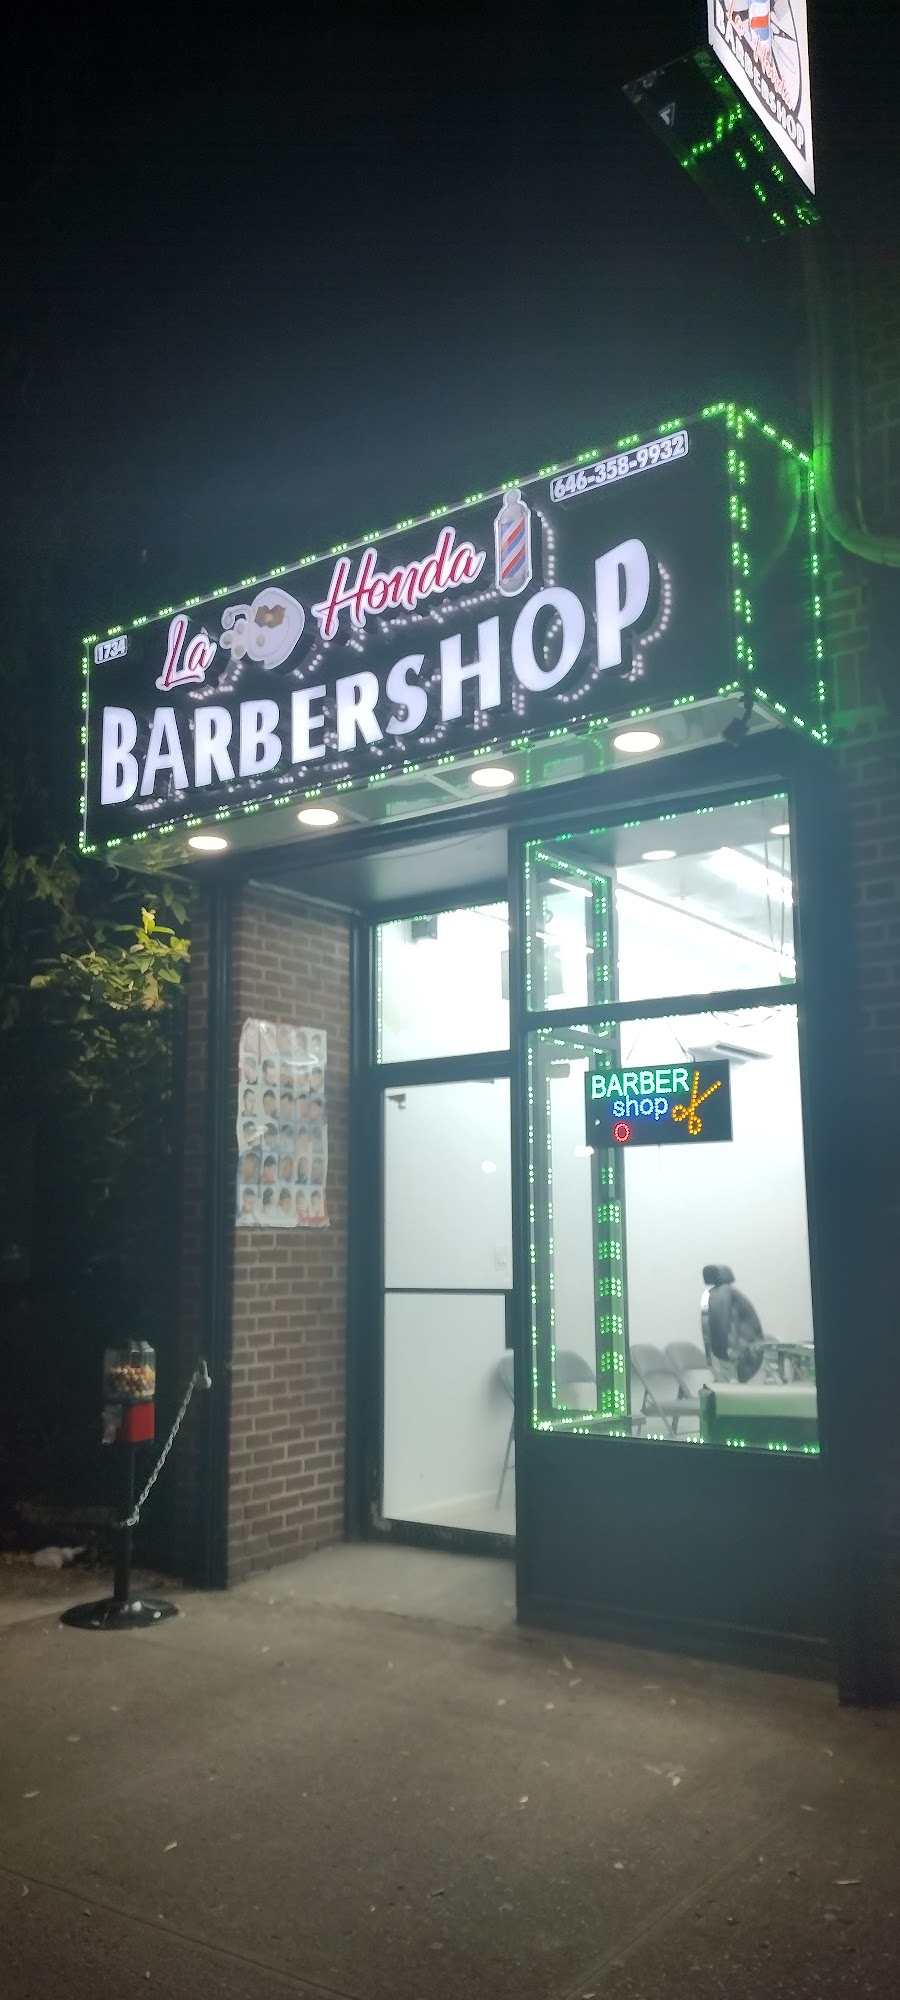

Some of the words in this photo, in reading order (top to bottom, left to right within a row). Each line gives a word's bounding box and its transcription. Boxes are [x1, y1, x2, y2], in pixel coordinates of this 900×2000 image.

[554, 435, 685, 498] 646-358-9932
[157, 614, 217, 691] La
[311, 526, 486, 640] Honda
[97, 638, 126, 661] 1734
[101, 539, 650, 805] BARBERSHOP
[591, 1067, 690, 1100] BARBER
[612, 1095, 669, 1121] shop
